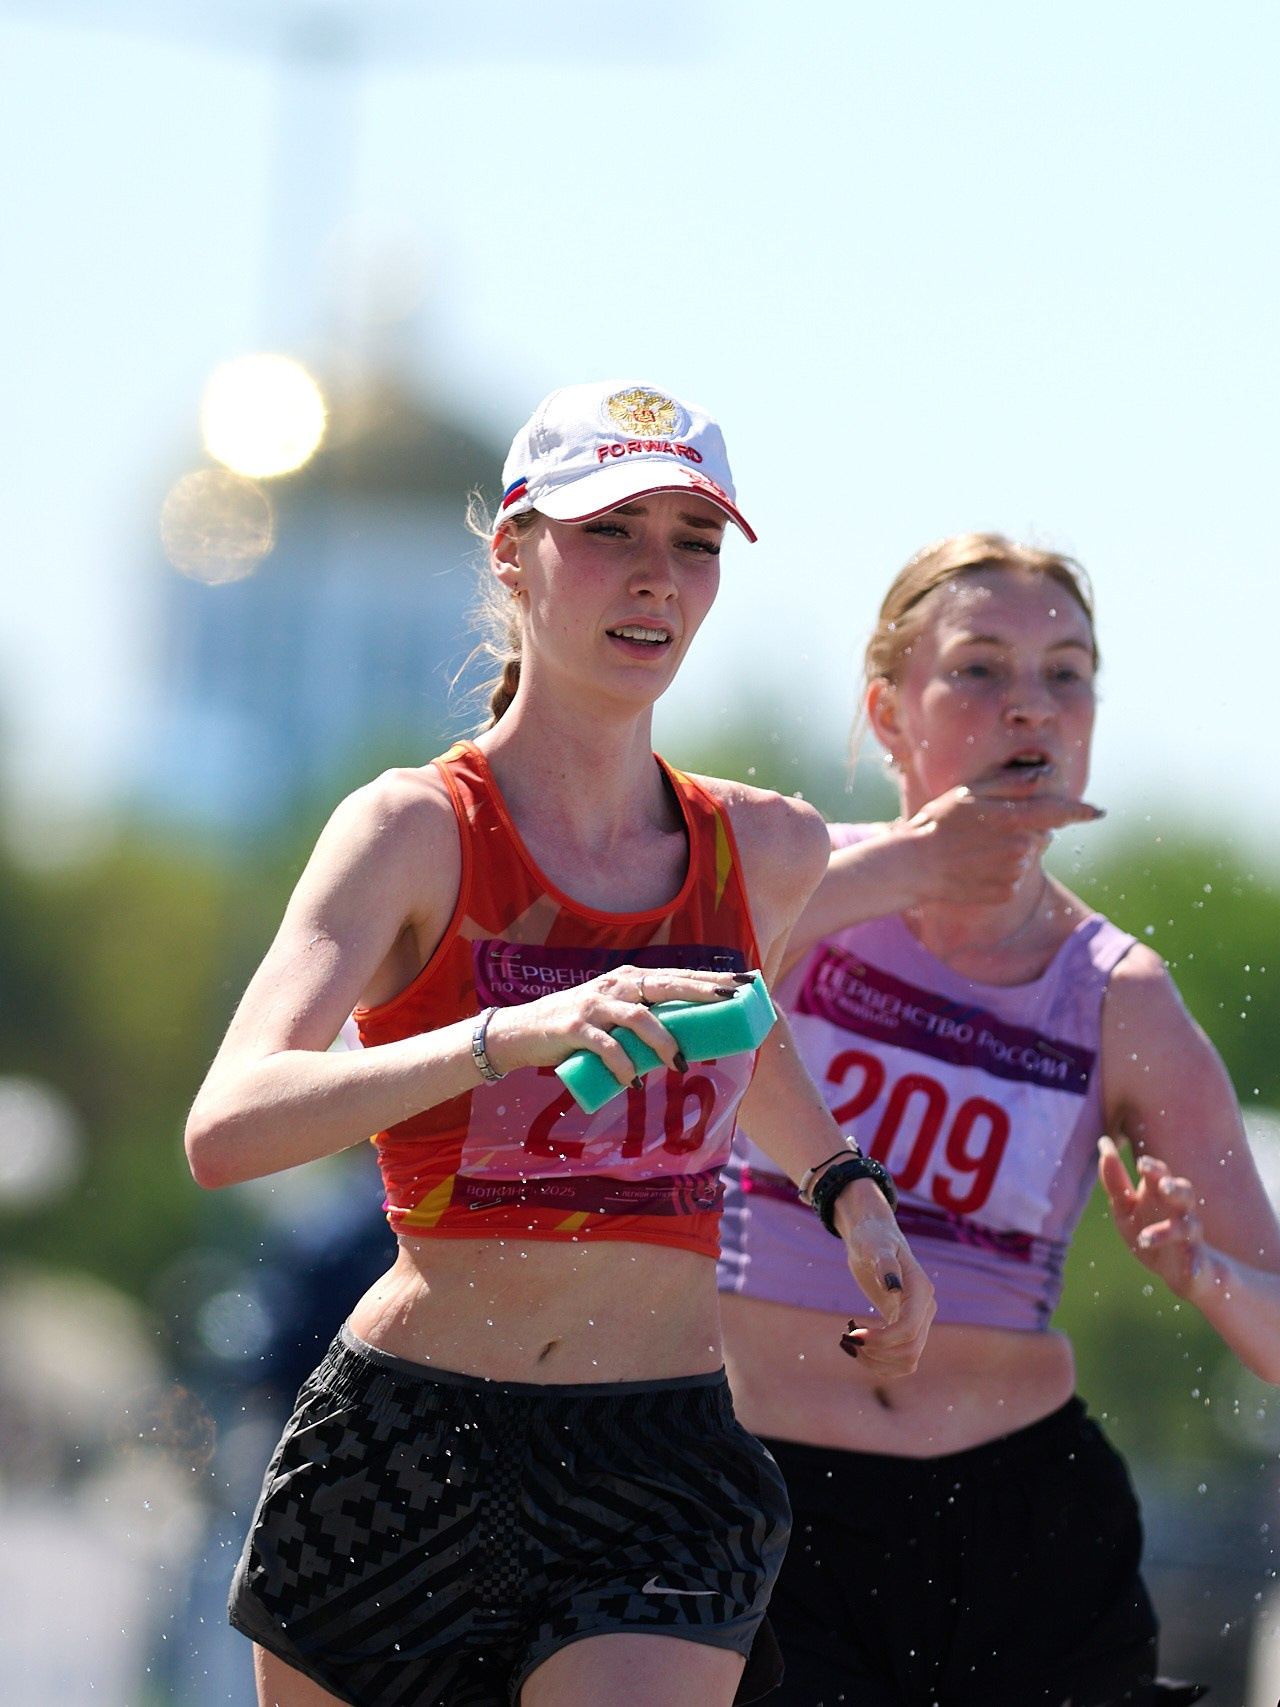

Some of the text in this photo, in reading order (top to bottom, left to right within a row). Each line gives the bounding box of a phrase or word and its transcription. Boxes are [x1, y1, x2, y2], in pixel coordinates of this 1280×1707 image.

[596, 439, 703, 464] FORWARD
[487, 962, 606, 985] ПЕРВЕНС
[523, 1061, 717, 1159] 216
[823, 1048, 1012, 1215] 209
[542, 1185, 576, 1197] 2025
